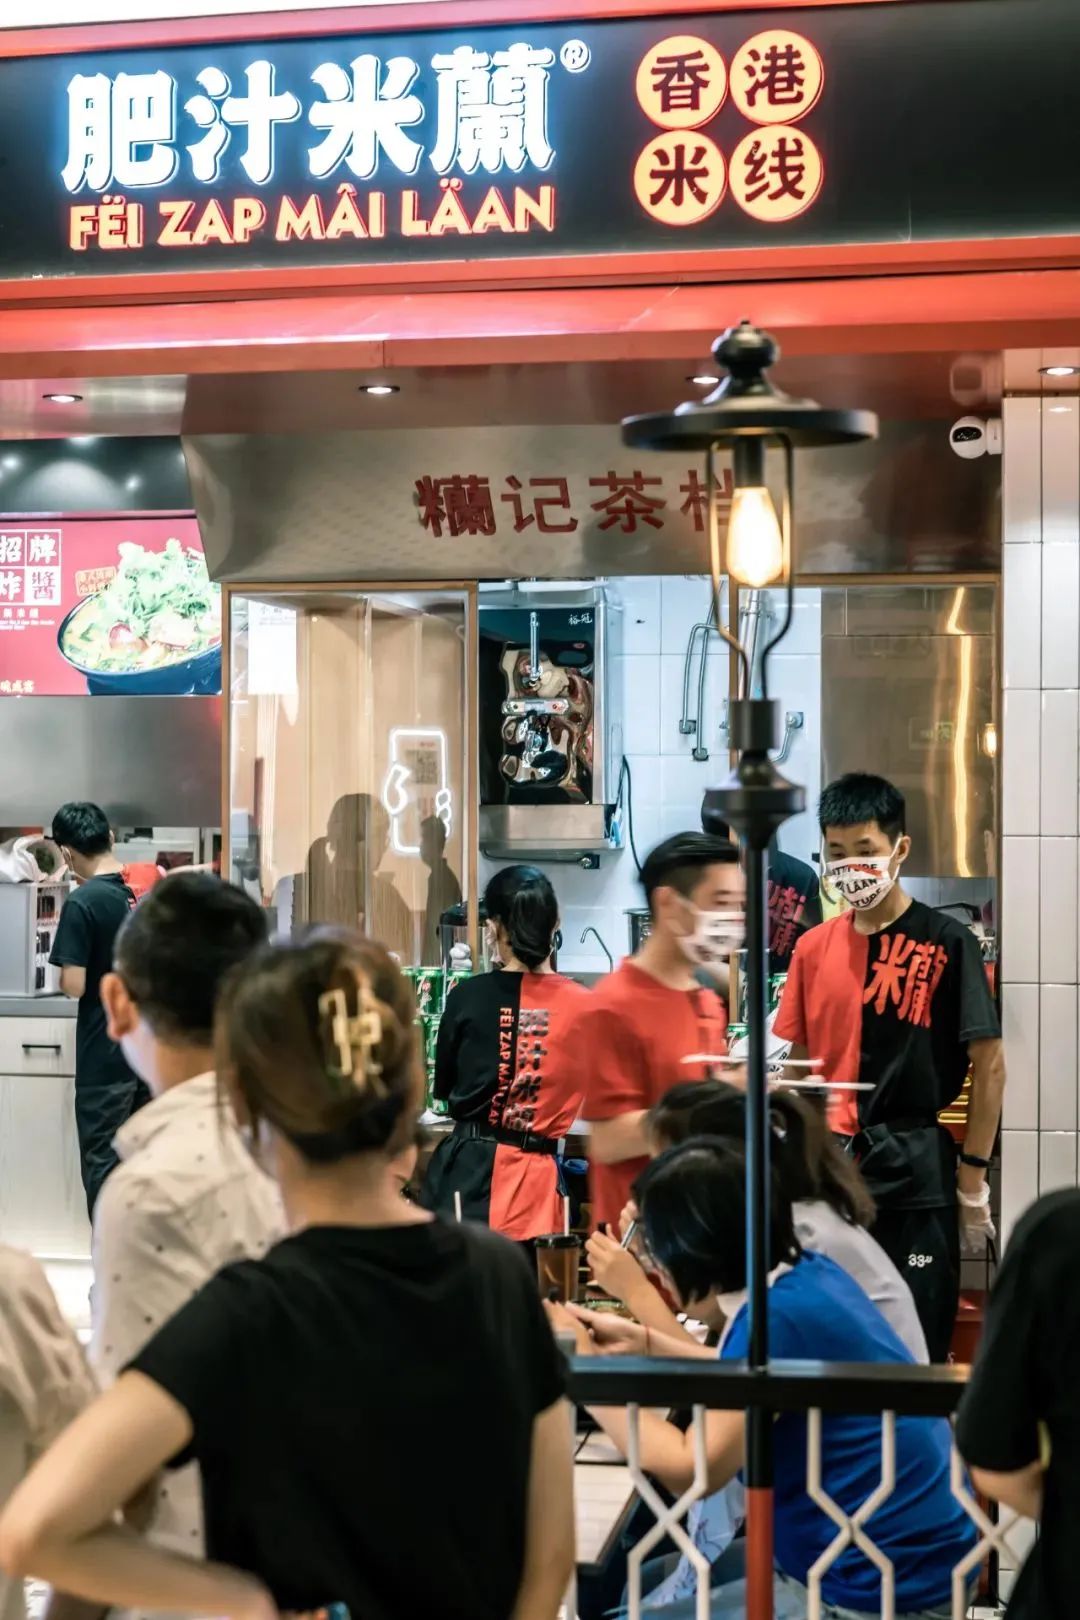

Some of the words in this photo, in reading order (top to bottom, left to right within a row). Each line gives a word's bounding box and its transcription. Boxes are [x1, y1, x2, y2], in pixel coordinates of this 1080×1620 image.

[651, 44, 806, 113] 香港
[61, 43, 557, 193] 肥汁米蘭
[649, 137, 806, 207] 米线
[69, 194, 143, 251] FËI
[157, 197, 268, 247] ZAP
[275, 182, 386, 242] MÂI
[401, 178, 556, 237] LÄAN
[500, 1031, 513, 1060] ZAP
